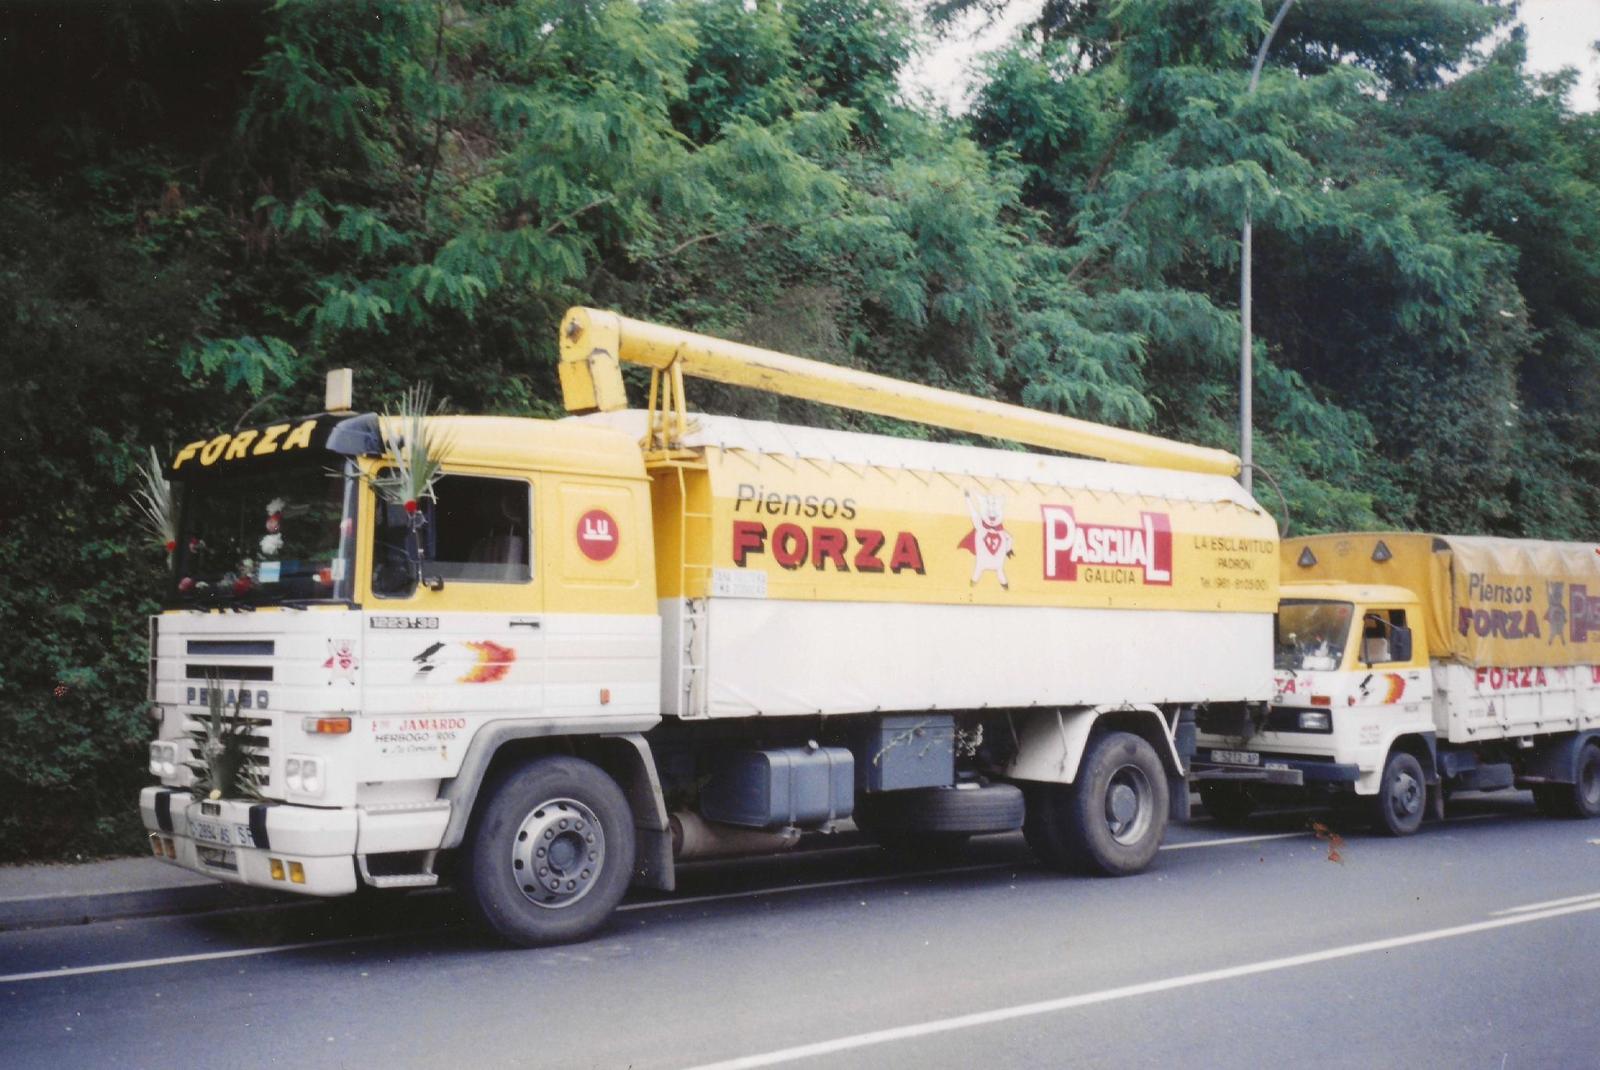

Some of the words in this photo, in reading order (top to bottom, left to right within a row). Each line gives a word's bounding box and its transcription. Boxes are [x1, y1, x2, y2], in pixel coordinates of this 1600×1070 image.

[173, 420, 317, 470] FORZA
[735, 484, 857, 520] Piensos
[732, 520, 927, 576] FORZA
[1043, 507, 1170, 580] PASCUAL
[1194, 536, 1207, 549] LA
[1085, 567, 1137, 585] GALICIA
[1469, 573, 1532, 605] Piensos
[1458, 606, 1541, 641] FORZA
[1475, 666, 1547, 691] FORZA
[400, 718, 466, 732] JAMARDO
